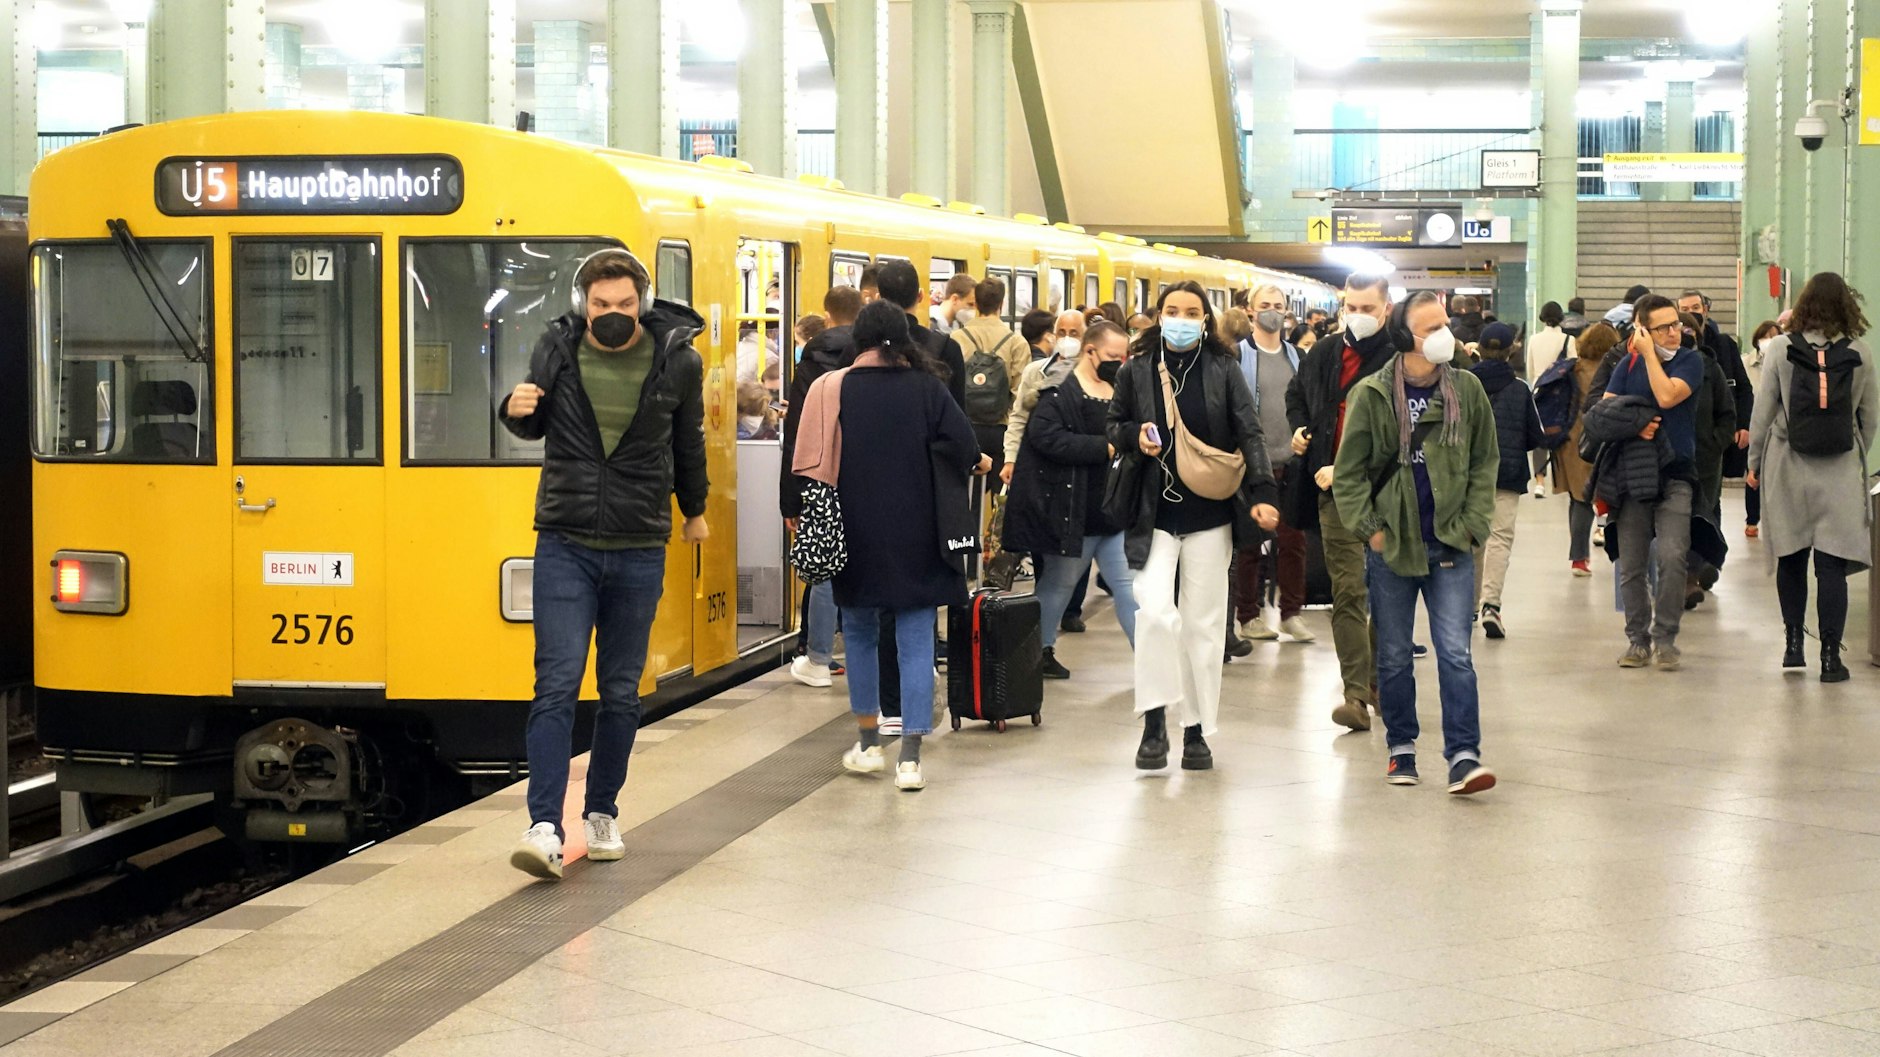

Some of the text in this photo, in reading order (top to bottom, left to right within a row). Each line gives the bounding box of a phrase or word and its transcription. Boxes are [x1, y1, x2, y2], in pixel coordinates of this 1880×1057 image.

[1486, 158, 1517, 168] Gleis 1
[1487, 170, 1536, 180] Platform 1
[181, 163, 441, 205] U5 Hauptbahnhof
[947, 535, 975, 551] Vinted
[271, 562, 317, 575] BERLIN
[707, 591, 726, 623] 2576
[271, 613, 354, 646] 2576
